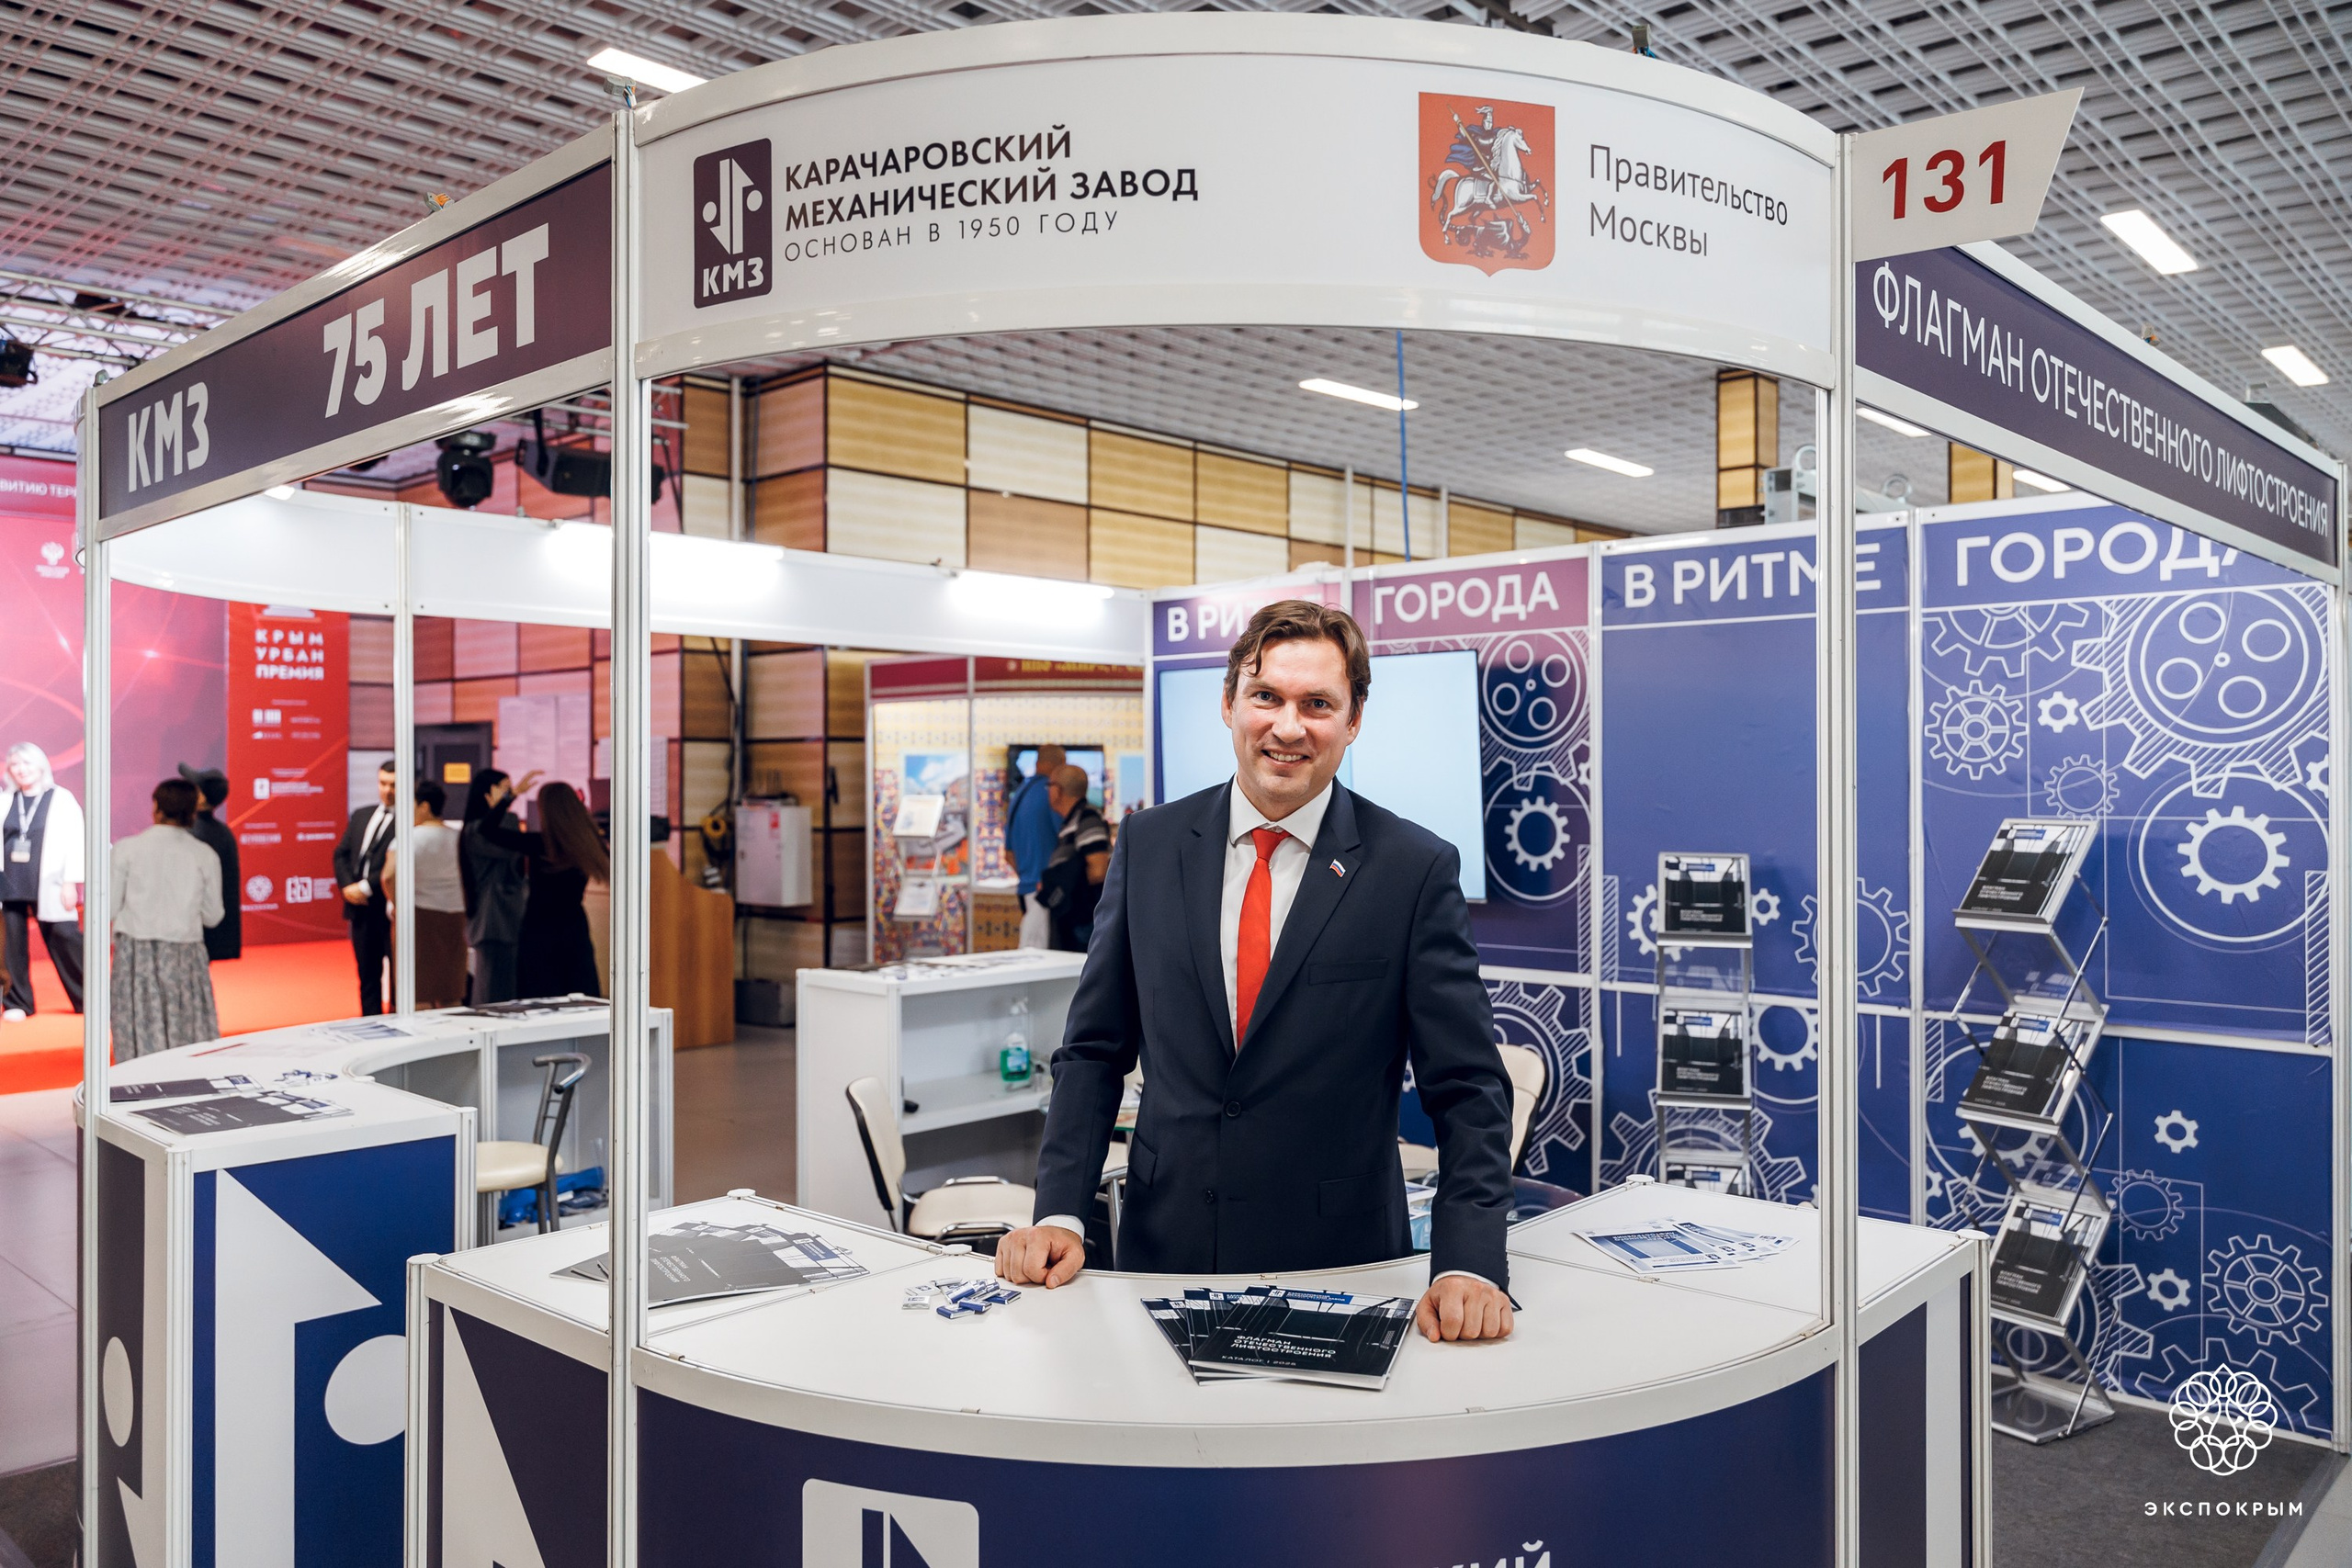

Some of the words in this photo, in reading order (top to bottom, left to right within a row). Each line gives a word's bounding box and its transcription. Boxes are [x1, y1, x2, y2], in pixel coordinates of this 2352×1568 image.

[786, 124, 1072, 193] КАРАЧАРОВСКИЙ
[1882, 139, 2007, 220] 131
[786, 165, 1057, 231] МЕХАНИЧЕСКИЙ
[1069, 167, 1199, 201] ЗАВОД
[1589, 144, 1789, 229] Правительство
[784, 225, 911, 263] ОСНОВАН
[928, 222, 942, 243] В
[957, 215, 1021, 241] 1950
[1038, 210, 1119, 236] ГОДУ
[1589, 200, 1709, 258] Москвы
[702, 256, 764, 299] КМЗ
[322, 298, 387, 419] 75
[401, 222, 550, 392] ЛЕТ
[1872, 260, 2024, 394] ФЛАГМАН
[2030, 347, 2212, 482] ОТЕЧЕСТВЕННОГО
[2215, 447, 2329, 538] ЛИФТОСТРОЕНИЯ
[127, 380, 210, 493] КМЗ
[1956, 521, 2242, 587] ГОРОД
[1374, 570, 1560, 626] ГОРОДА
[1624, 564, 1656, 608] В
[254, 628, 323, 646] КРЫМ
[1167, 605, 1190, 642] В
[254, 646, 324, 663] УРБАН
[255, 663, 324, 681] ПРЕМИЯ
[1230, 1343, 1332, 1359] ЛИФТОСТРОЕНИЯ
[1233, 1338, 1337, 1355] ОТЕЧЕСТВЕННОГО
[1237, 1335, 1292, 1346] ФЛАГМАН
